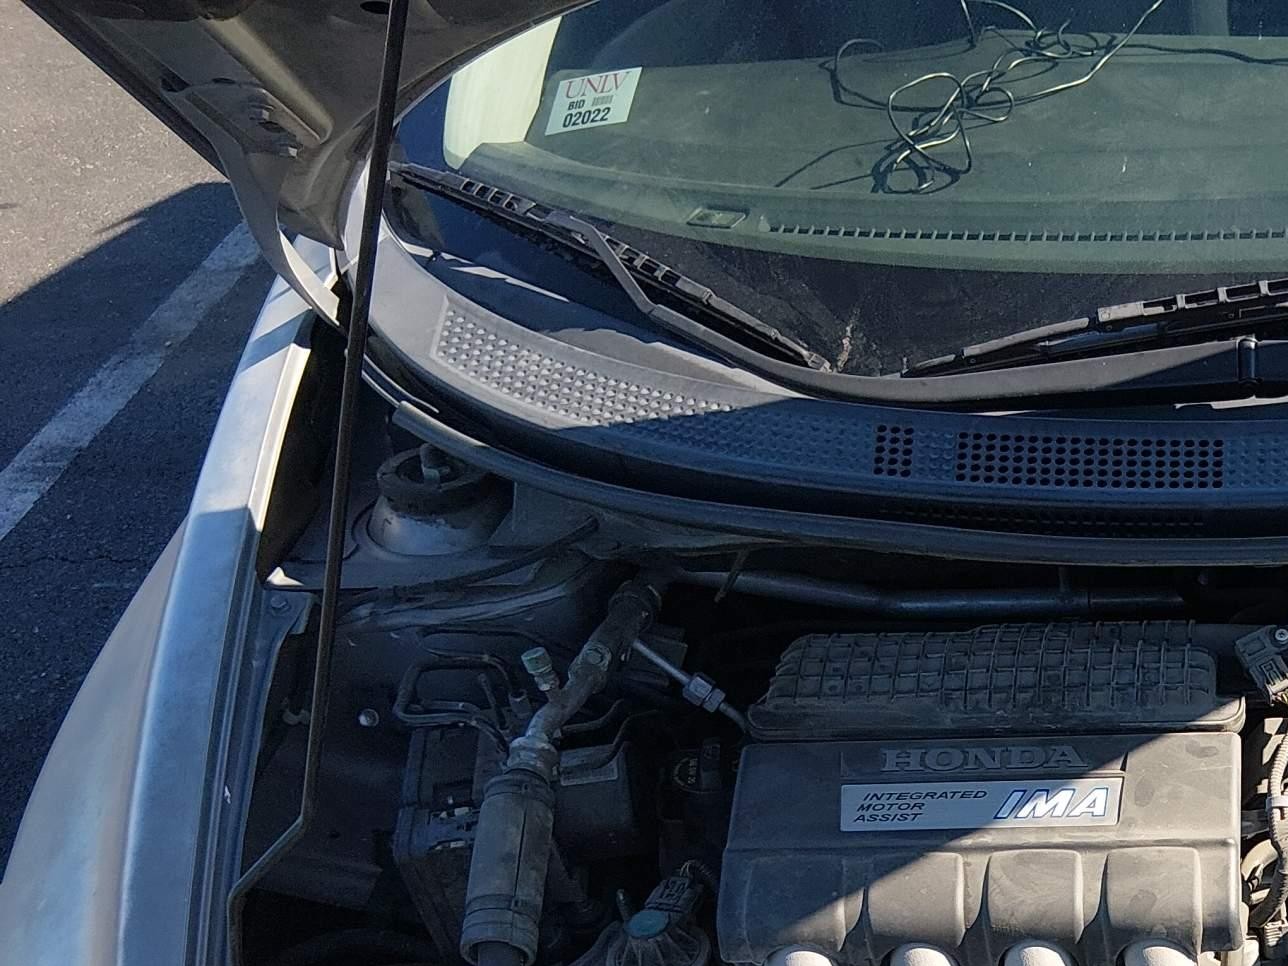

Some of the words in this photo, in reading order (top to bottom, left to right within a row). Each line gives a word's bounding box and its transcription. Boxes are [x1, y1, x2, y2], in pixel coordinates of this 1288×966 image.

[566, 72, 631, 99] UNLV
[568, 100, 586, 111] BID
[562, 107, 611, 128] 02022
[880, 745, 1089, 773] HONDA
[863, 790, 988, 801] INTEGRATED
[993, 787, 1109, 819] IMA
[856, 801, 925, 812] MOTOR
[853, 812, 923, 823] ASSIST
